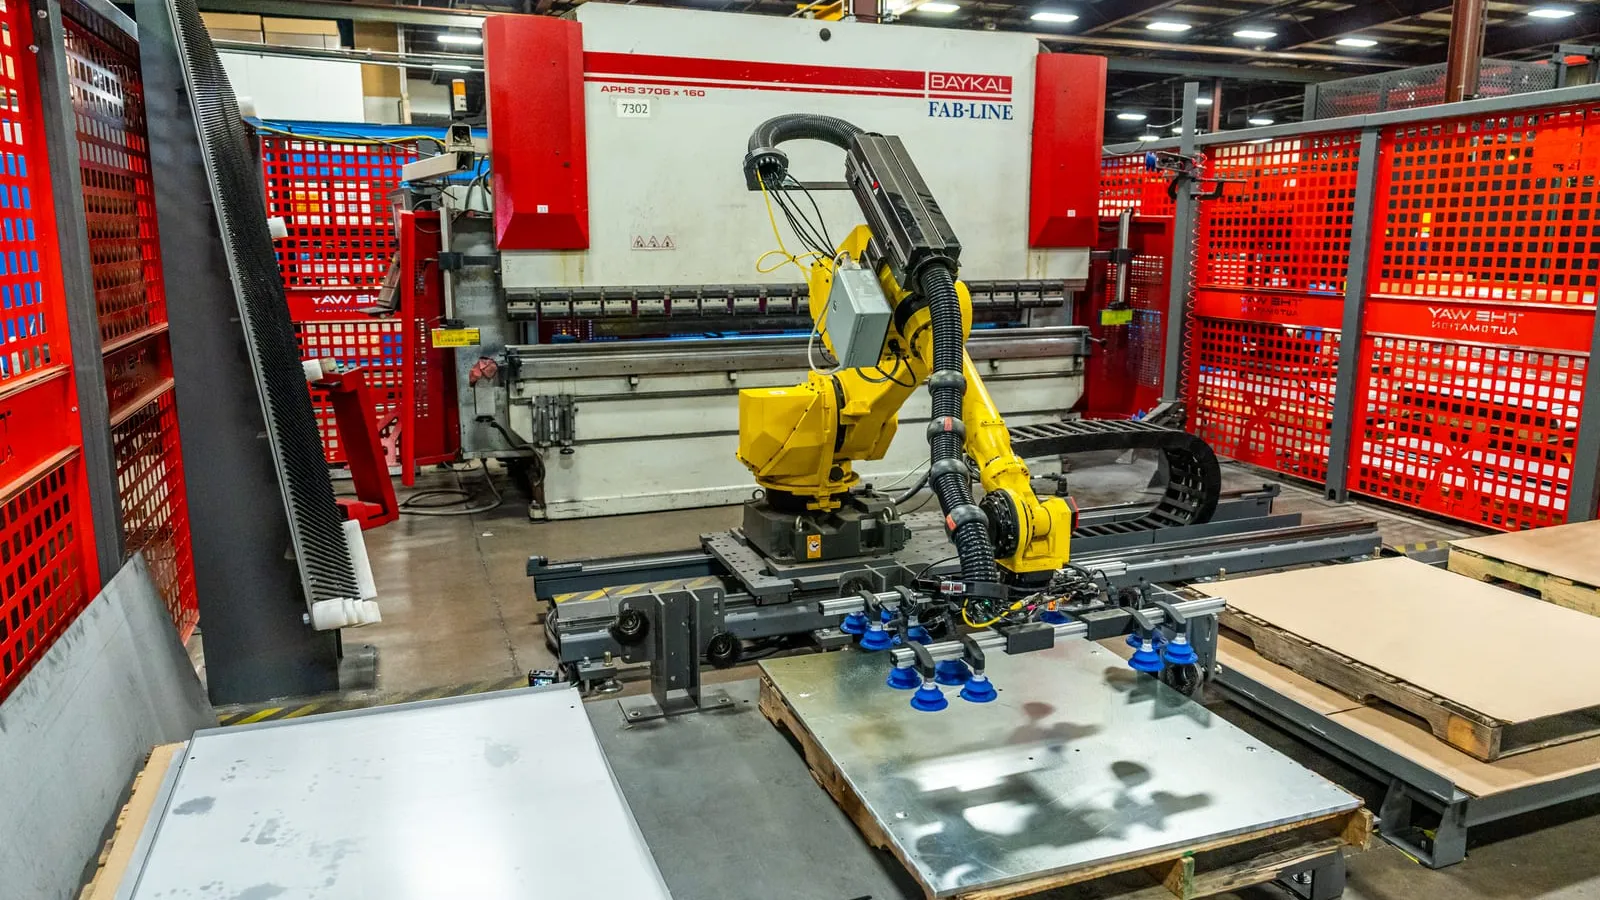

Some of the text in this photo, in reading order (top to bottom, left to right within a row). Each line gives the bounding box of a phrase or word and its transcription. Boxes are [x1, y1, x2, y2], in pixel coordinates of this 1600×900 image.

[931, 74, 1010, 92] BAYKAL
[601, 85, 636, 94] APHS
[638, 87, 671, 96] 3706
[683, 89, 706, 97] 160
[621, 103, 648, 114] 7302
[928, 101, 1014, 121] FAB-LINE
